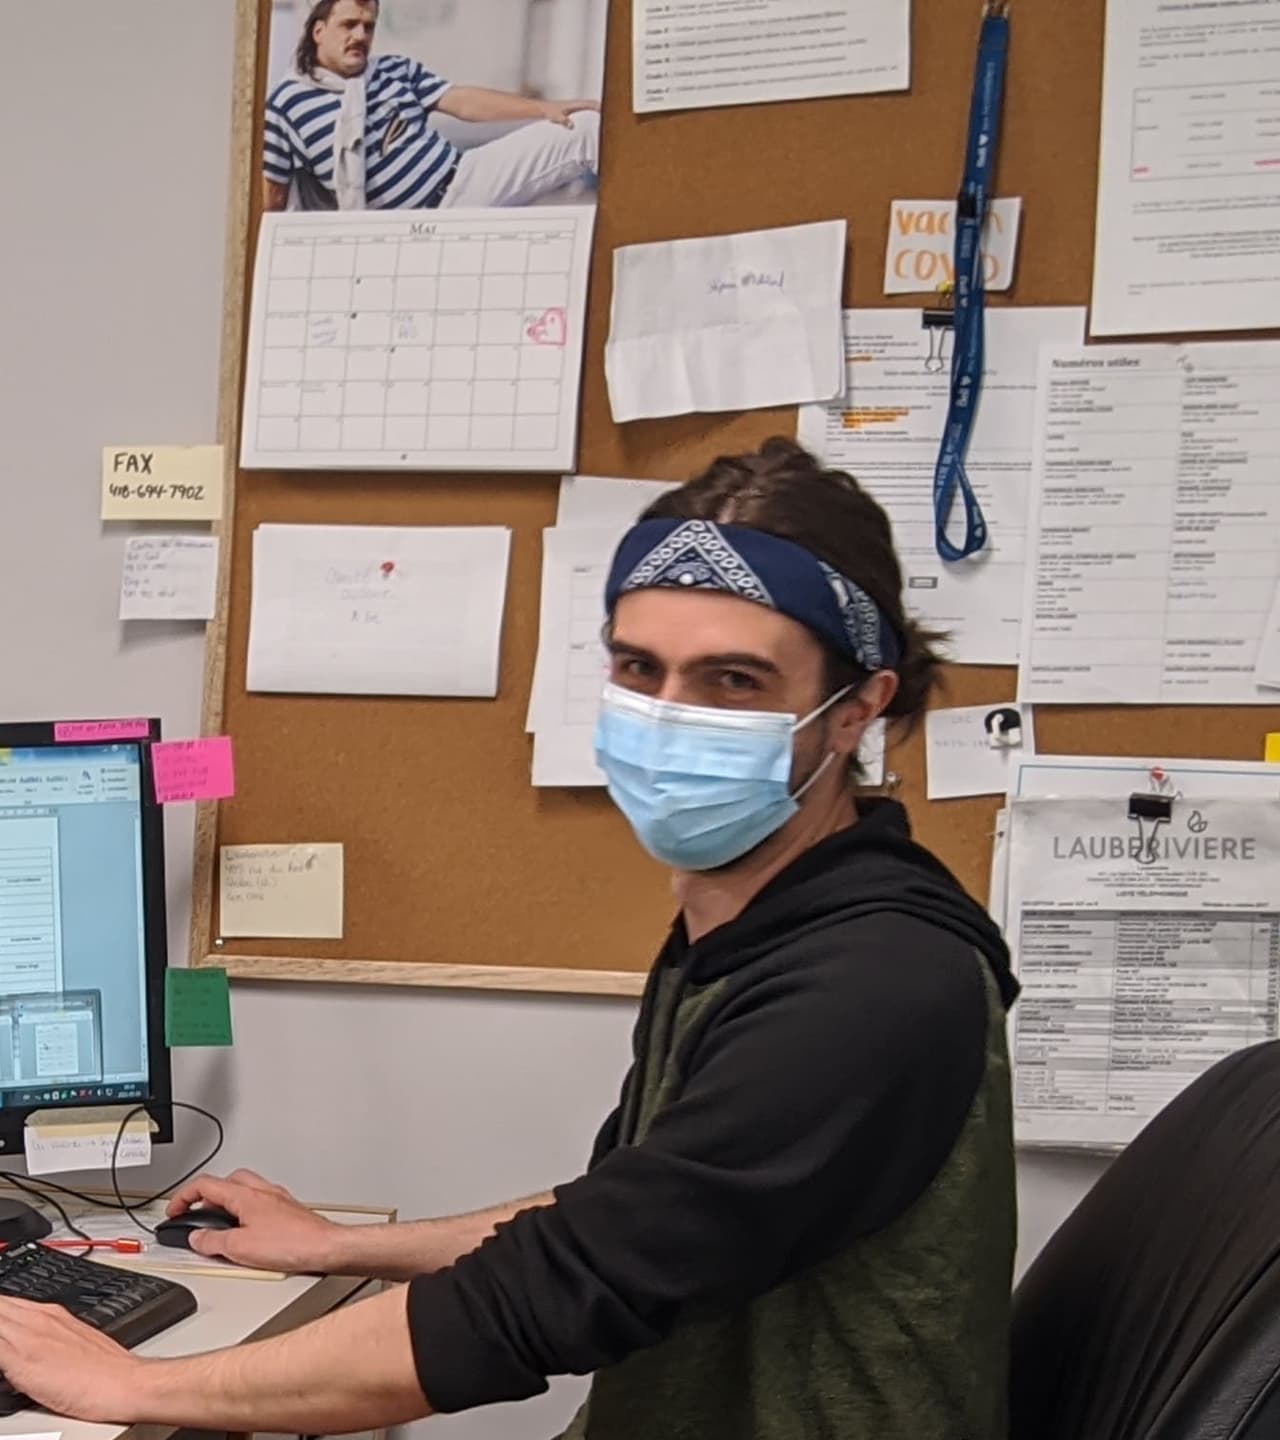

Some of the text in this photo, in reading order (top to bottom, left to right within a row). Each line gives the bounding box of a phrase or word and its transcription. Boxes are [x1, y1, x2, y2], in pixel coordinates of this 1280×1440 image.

[113, 452, 154, 474] FAX
[108, 483, 205, 501] 418-694-7902
[1053, 835, 1256, 860] LAUBERIVIERE
